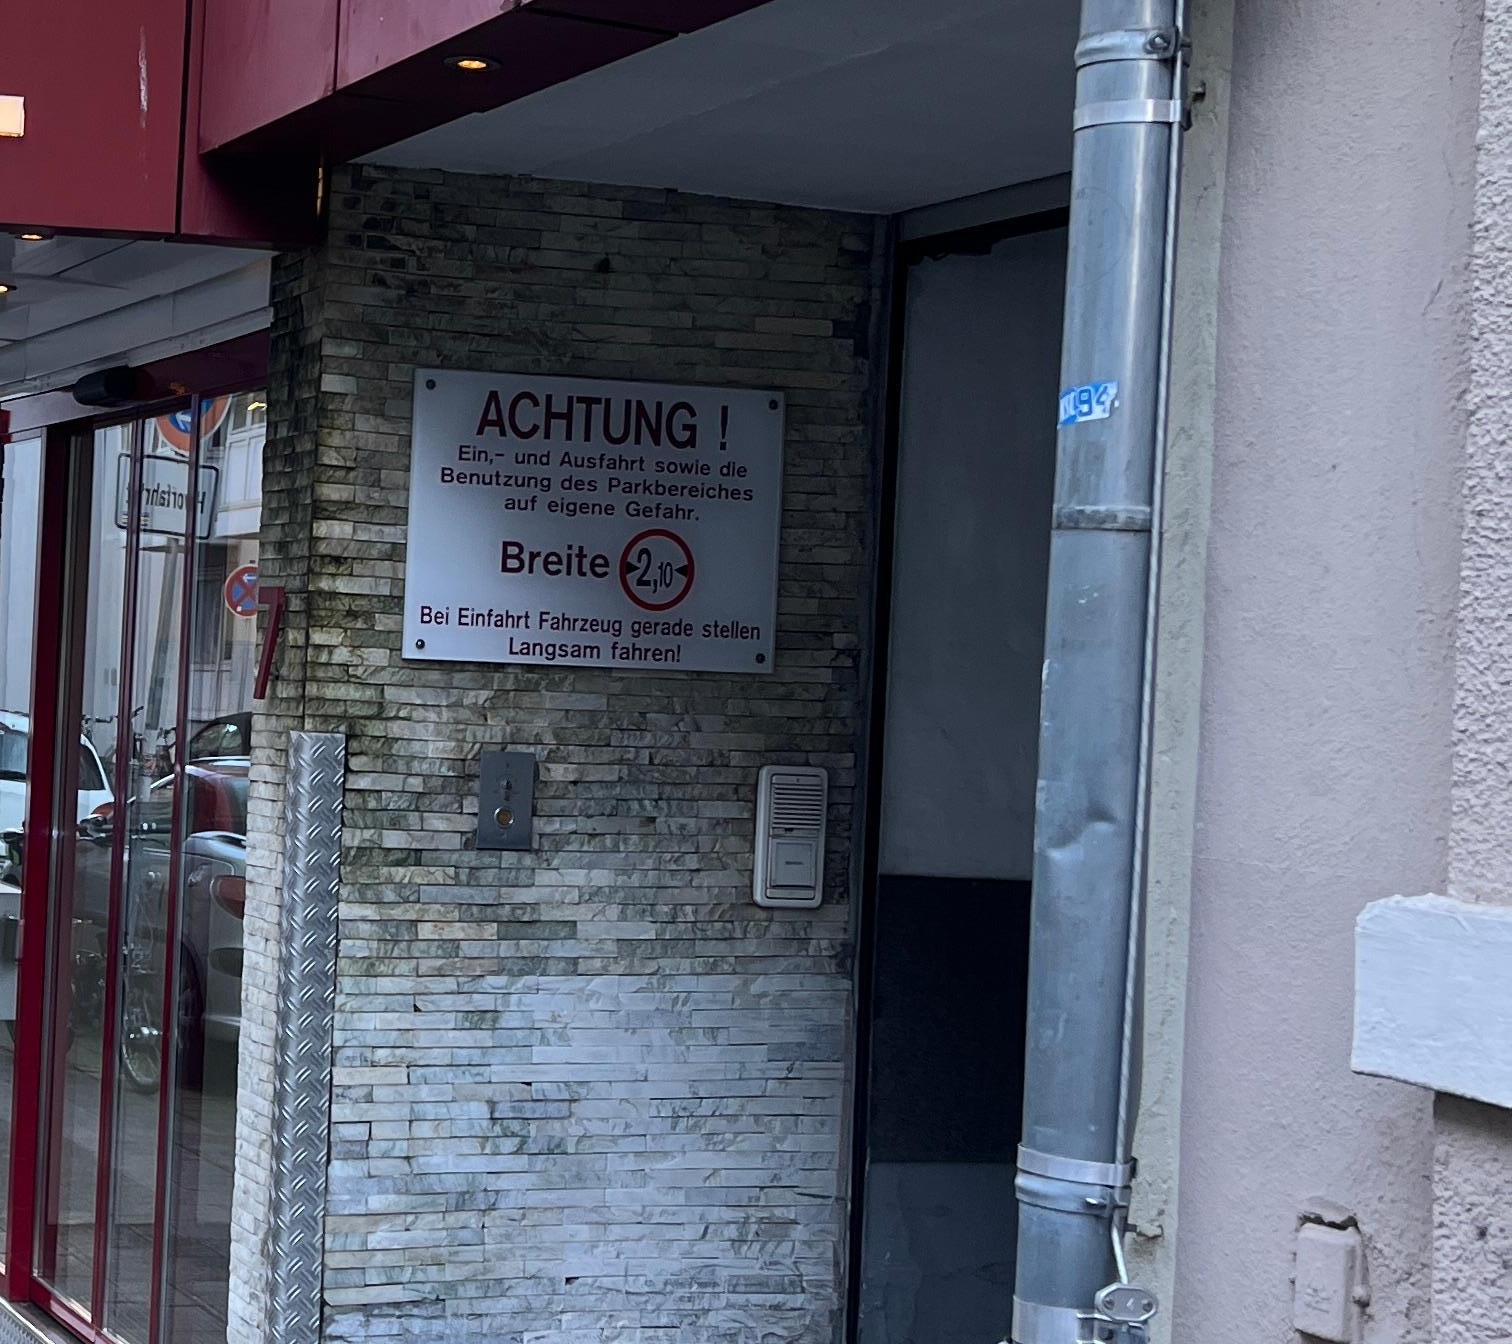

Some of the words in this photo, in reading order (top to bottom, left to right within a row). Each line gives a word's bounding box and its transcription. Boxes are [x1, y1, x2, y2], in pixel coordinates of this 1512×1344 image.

[476, 390, 697, 449] ACHTUNG
[514, 449, 550, 467] und
[560, 450, 646, 473] Ausfahrt
[654, 457, 711, 476] sowie
[719, 459, 748, 478] die
[440, 467, 552, 492] Benutzung
[561, 473, 598, 493] des
[608, 477, 754, 502] Parkbereiches
[504, 493, 538, 512] auf
[547, 497, 616, 517] eigene
[625, 501, 700, 522] Gefahr.
[500, 540, 610, 578] Breite
[635, 547, 674, 594] 2,10
[420, 605, 449, 626] Bei
[457, 608, 530, 630] Einfahrt
[538, 611, 623, 638] Fahrzeug
[631, 617, 694, 642] gerade
[701, 619, 760, 641] stellen
[254, 586, 285, 700] 7
[509, 637, 601, 661] Langsam
[611, 641, 681, 663] fahren!
